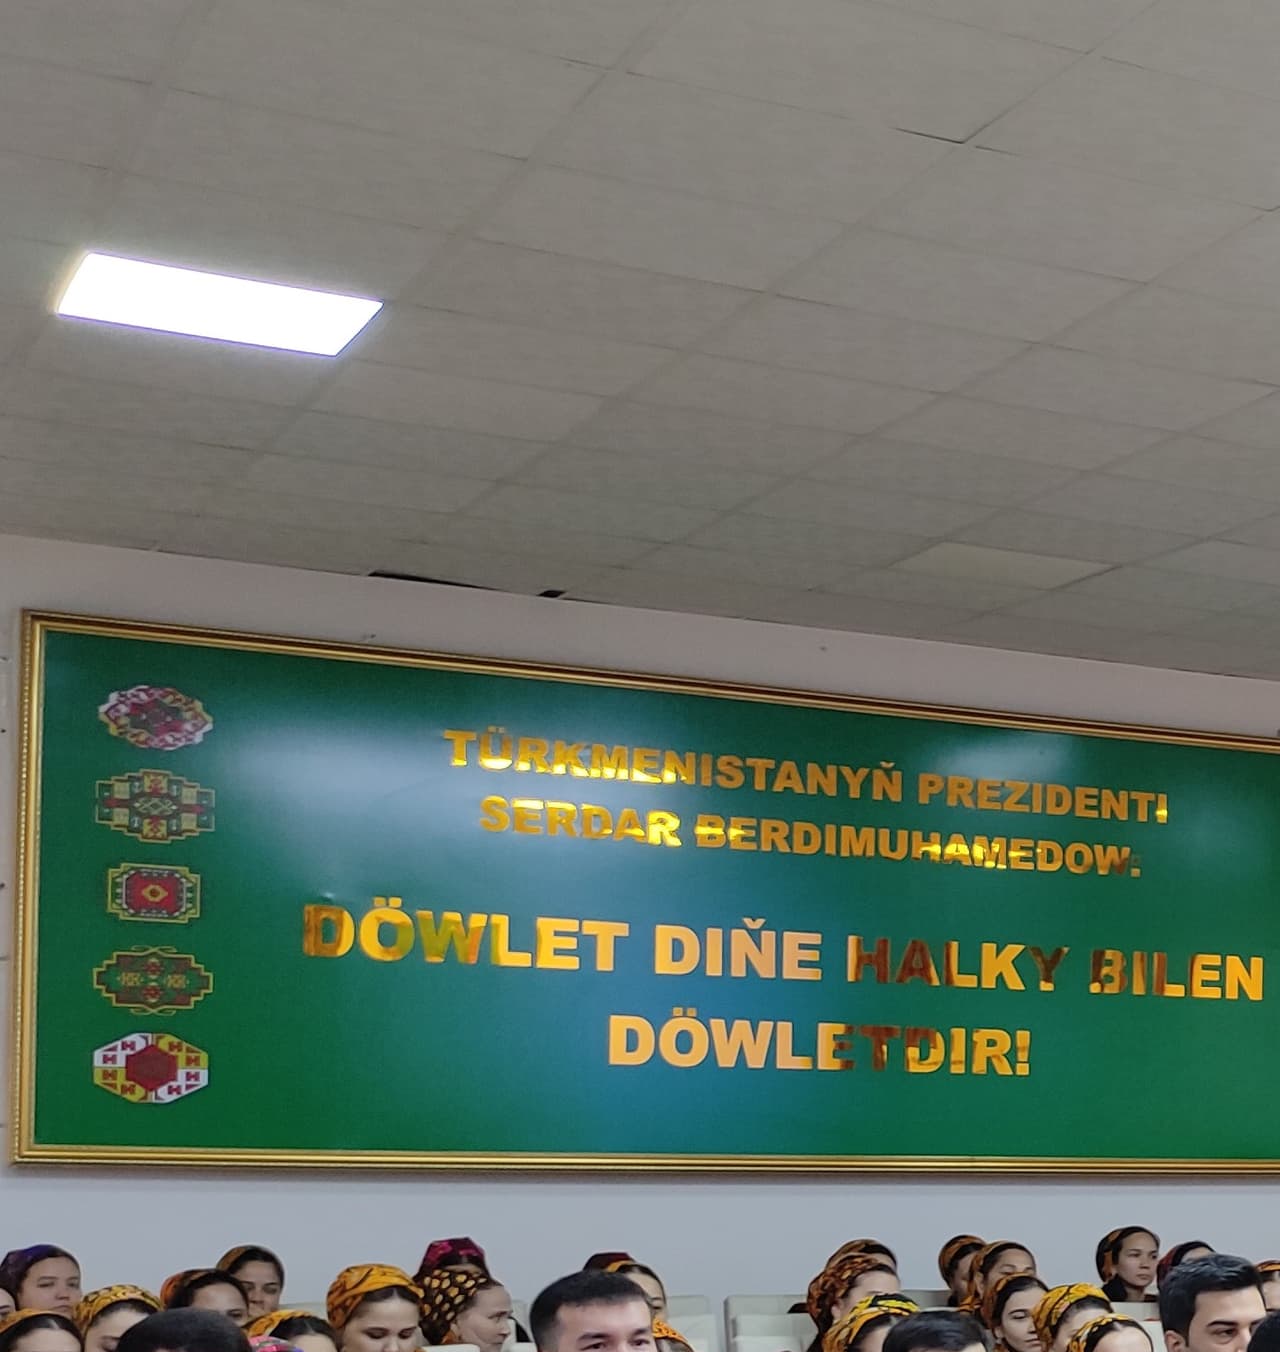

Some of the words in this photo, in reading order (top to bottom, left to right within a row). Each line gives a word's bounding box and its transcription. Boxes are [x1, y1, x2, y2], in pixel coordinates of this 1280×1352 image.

[444, 726, 903, 802] TÜRKMENISTANYŇ
[917, 773, 1169, 825] PREZIDENTI
[479, 795, 683, 848] SERDAR
[302, 896, 631, 972] DÖWLET
[654, 917, 823, 981] DIŇE
[846, 934, 1071, 992] HALKY
[1088, 949, 1265, 1001] BILEN
[608, 1006, 1032, 1077] DÖWLETDIR!
